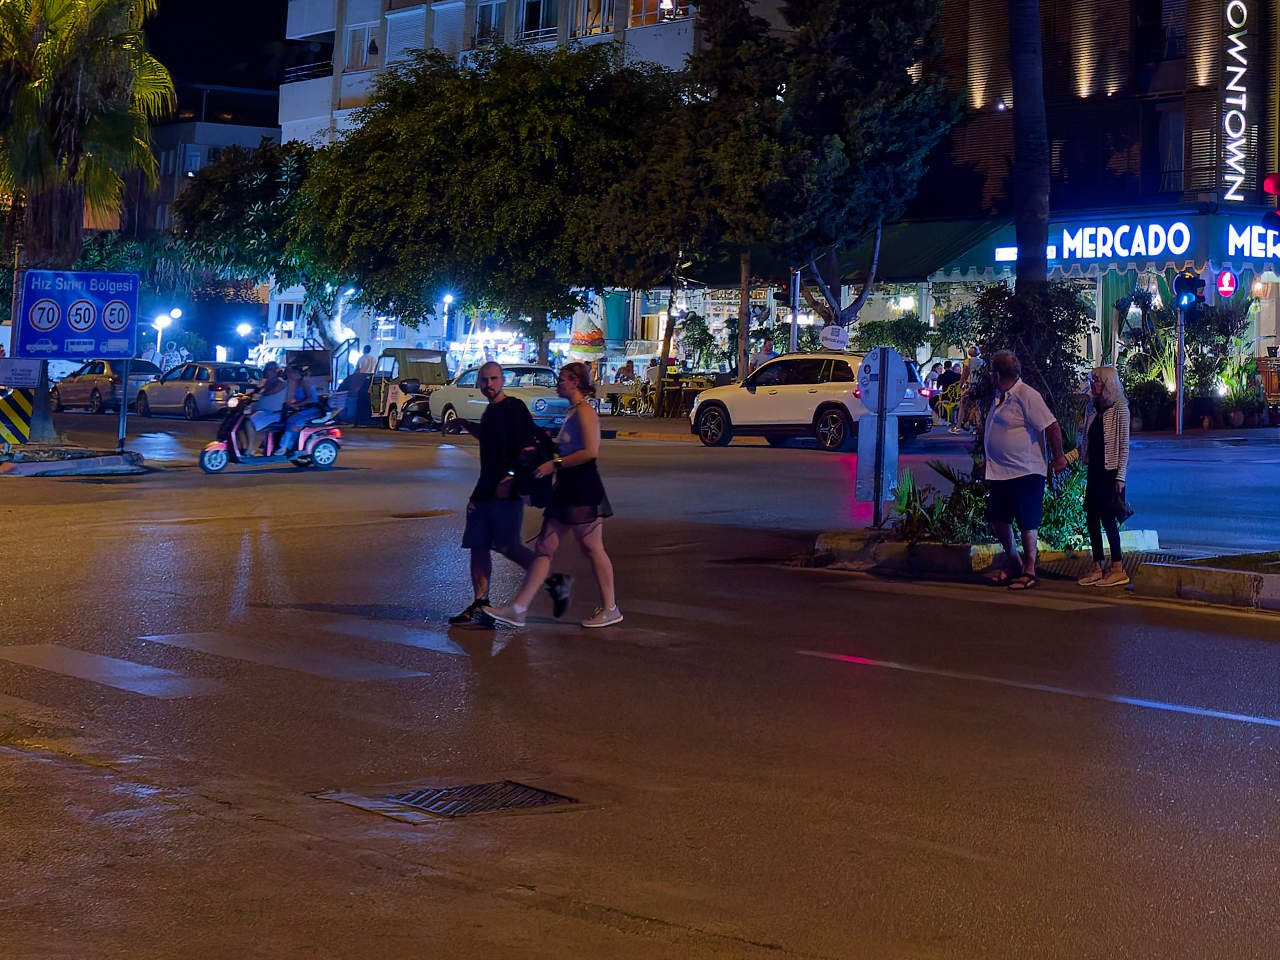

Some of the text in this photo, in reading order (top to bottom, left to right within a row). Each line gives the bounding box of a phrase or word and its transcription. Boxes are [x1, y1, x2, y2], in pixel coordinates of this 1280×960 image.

[1062, 222, 1191, 259] MERCADO
[89, 278, 133, 295] Bölgesi
[37, 306, 55, 324] 70
[74, 307, 91, 324] 50
[108, 307, 125, 325] 50
